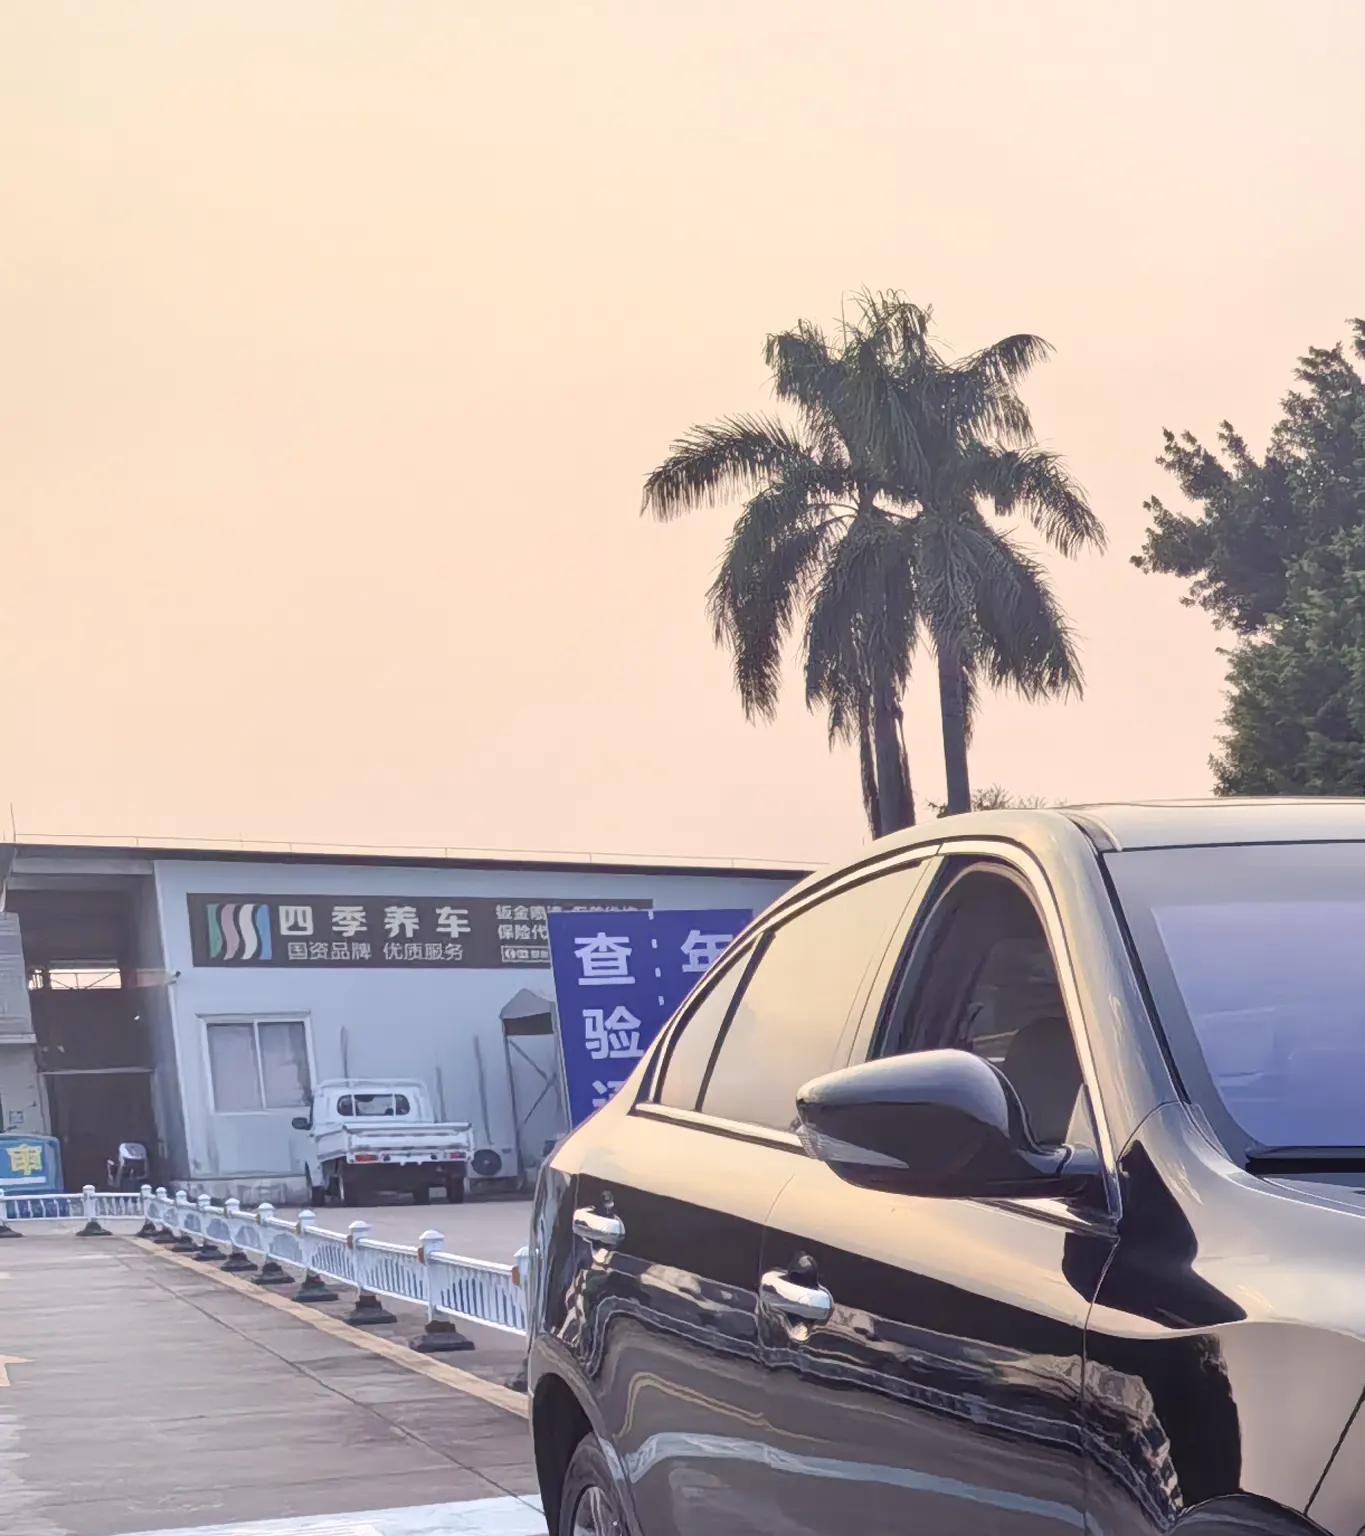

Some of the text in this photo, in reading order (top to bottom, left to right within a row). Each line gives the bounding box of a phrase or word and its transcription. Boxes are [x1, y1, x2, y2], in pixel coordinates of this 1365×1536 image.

[278, 905, 471, 938] 四季养车
[287, 941, 464, 961] 国资品牌 优质服务
